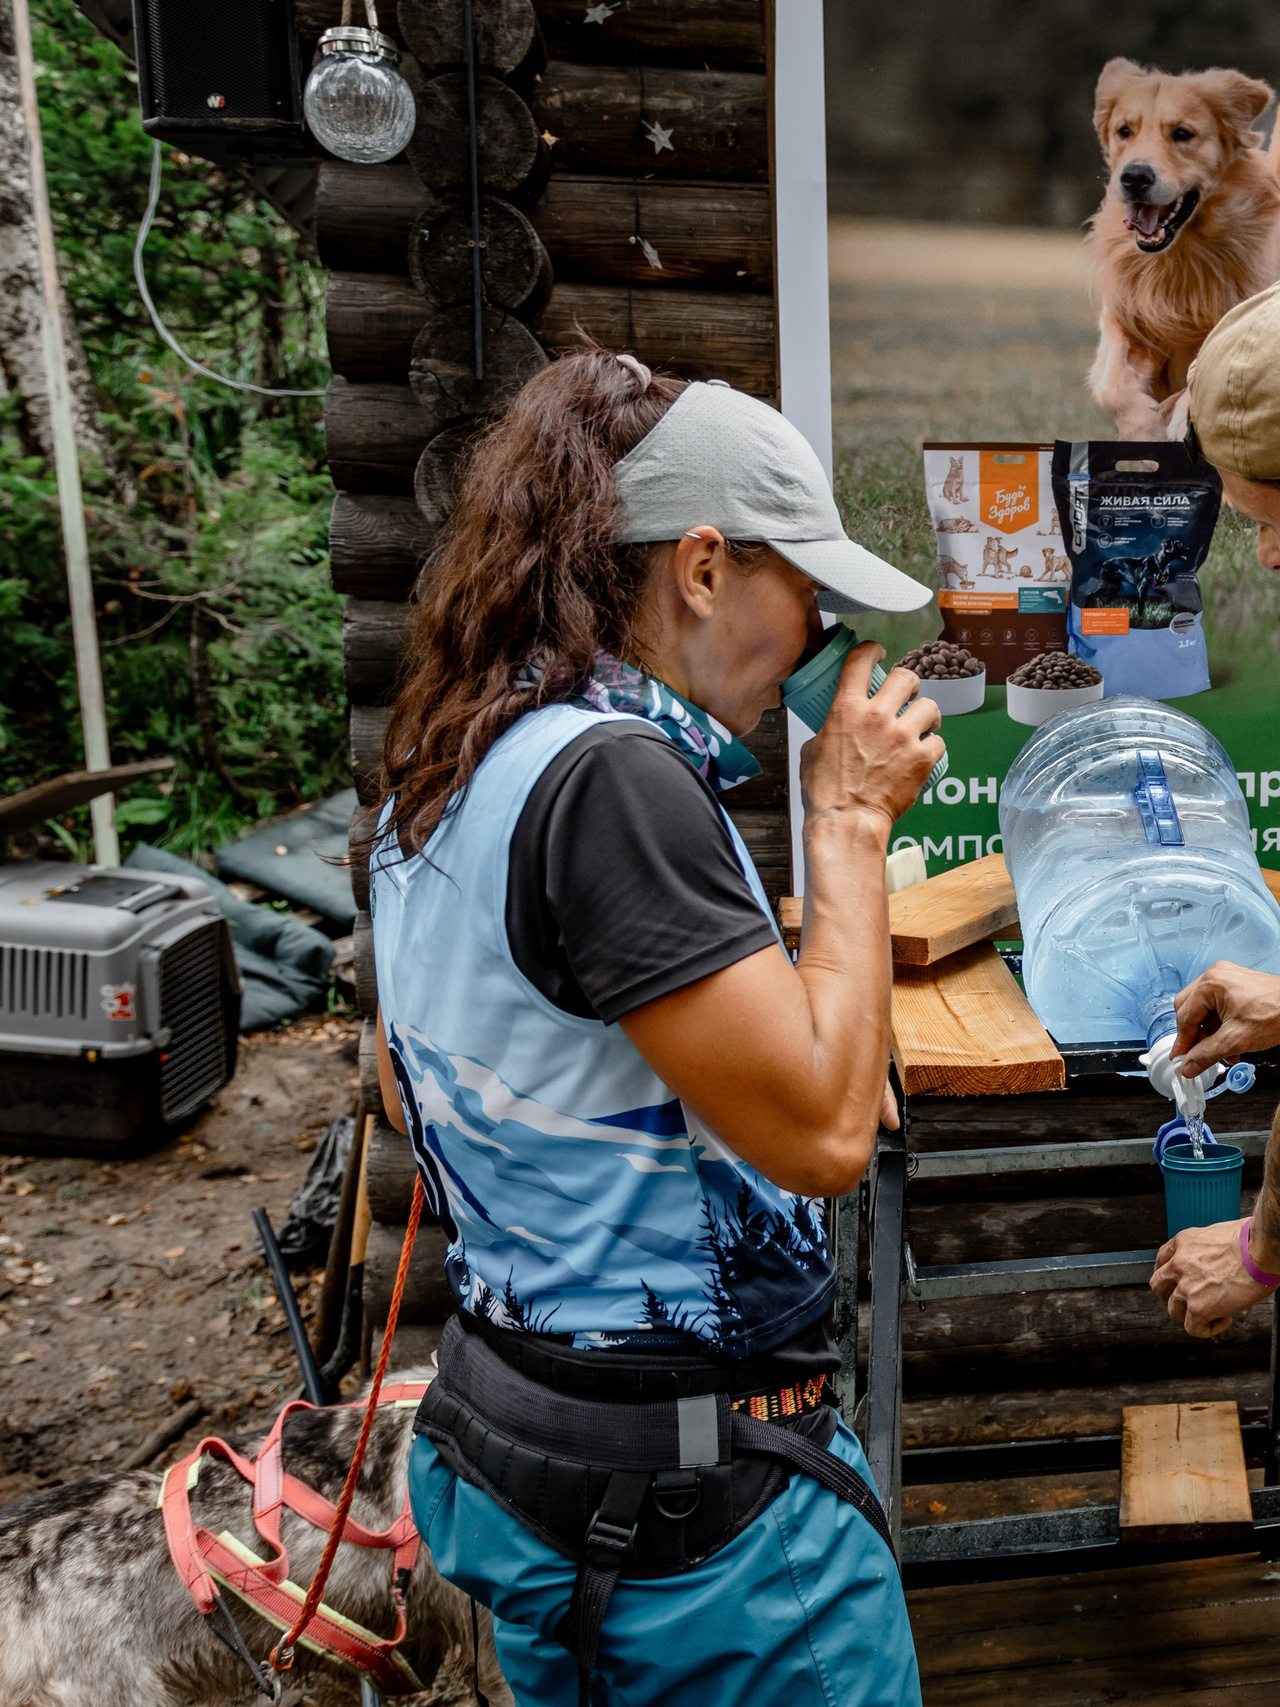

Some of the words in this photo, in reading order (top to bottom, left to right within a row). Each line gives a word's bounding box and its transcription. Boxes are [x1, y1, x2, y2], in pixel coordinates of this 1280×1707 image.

[995, 489, 1025, 507] Будь
[1100, 496, 1150, 506] ЖИВАЯ
[1153, 496, 1191, 506] СИЛА
[988, 496, 1031, 524] Здоров
[1073, 486, 1085, 548] СПОРТ
